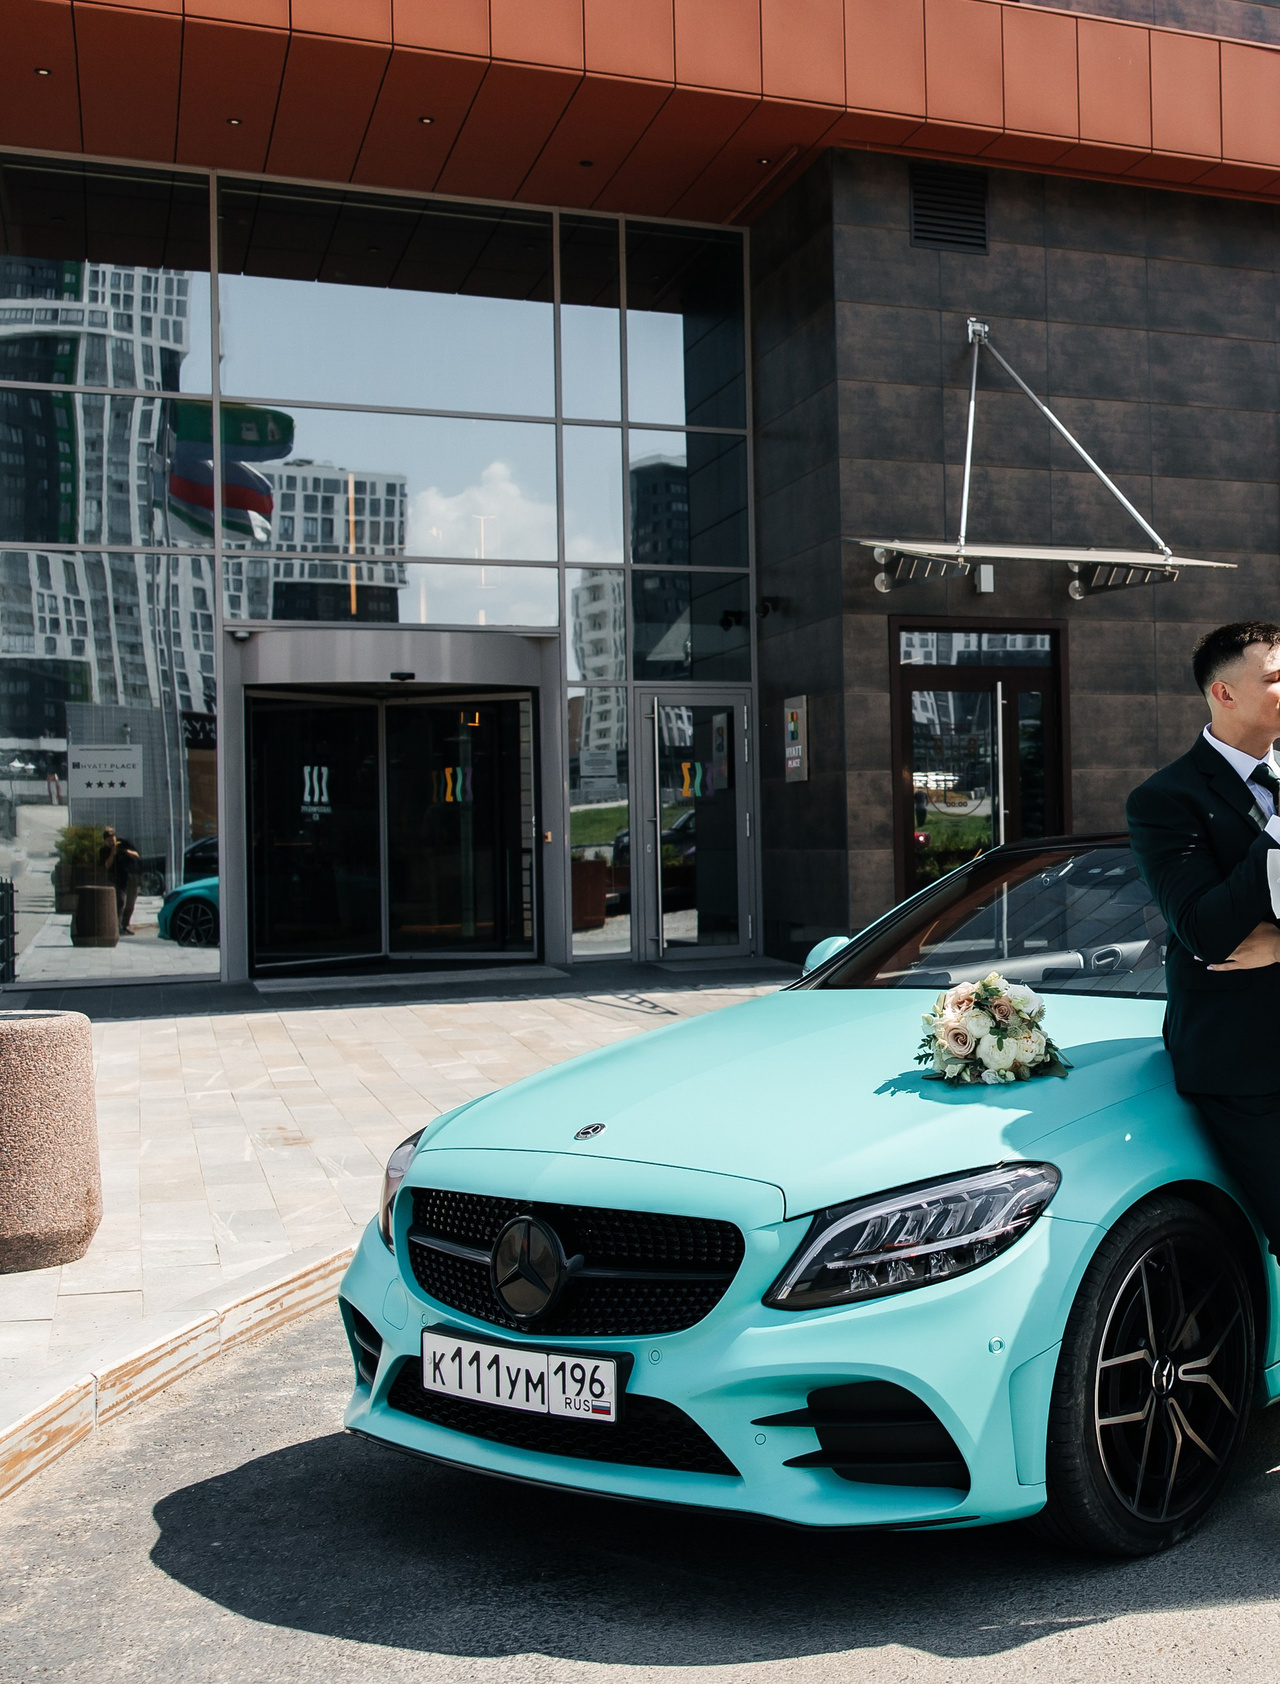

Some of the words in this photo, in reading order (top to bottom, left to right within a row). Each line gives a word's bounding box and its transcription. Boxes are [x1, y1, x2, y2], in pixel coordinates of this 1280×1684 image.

[432, 1346, 546, 1406] К111УМ
[553, 1361, 606, 1399] 196
[564, 1397, 591, 1412] RUS
